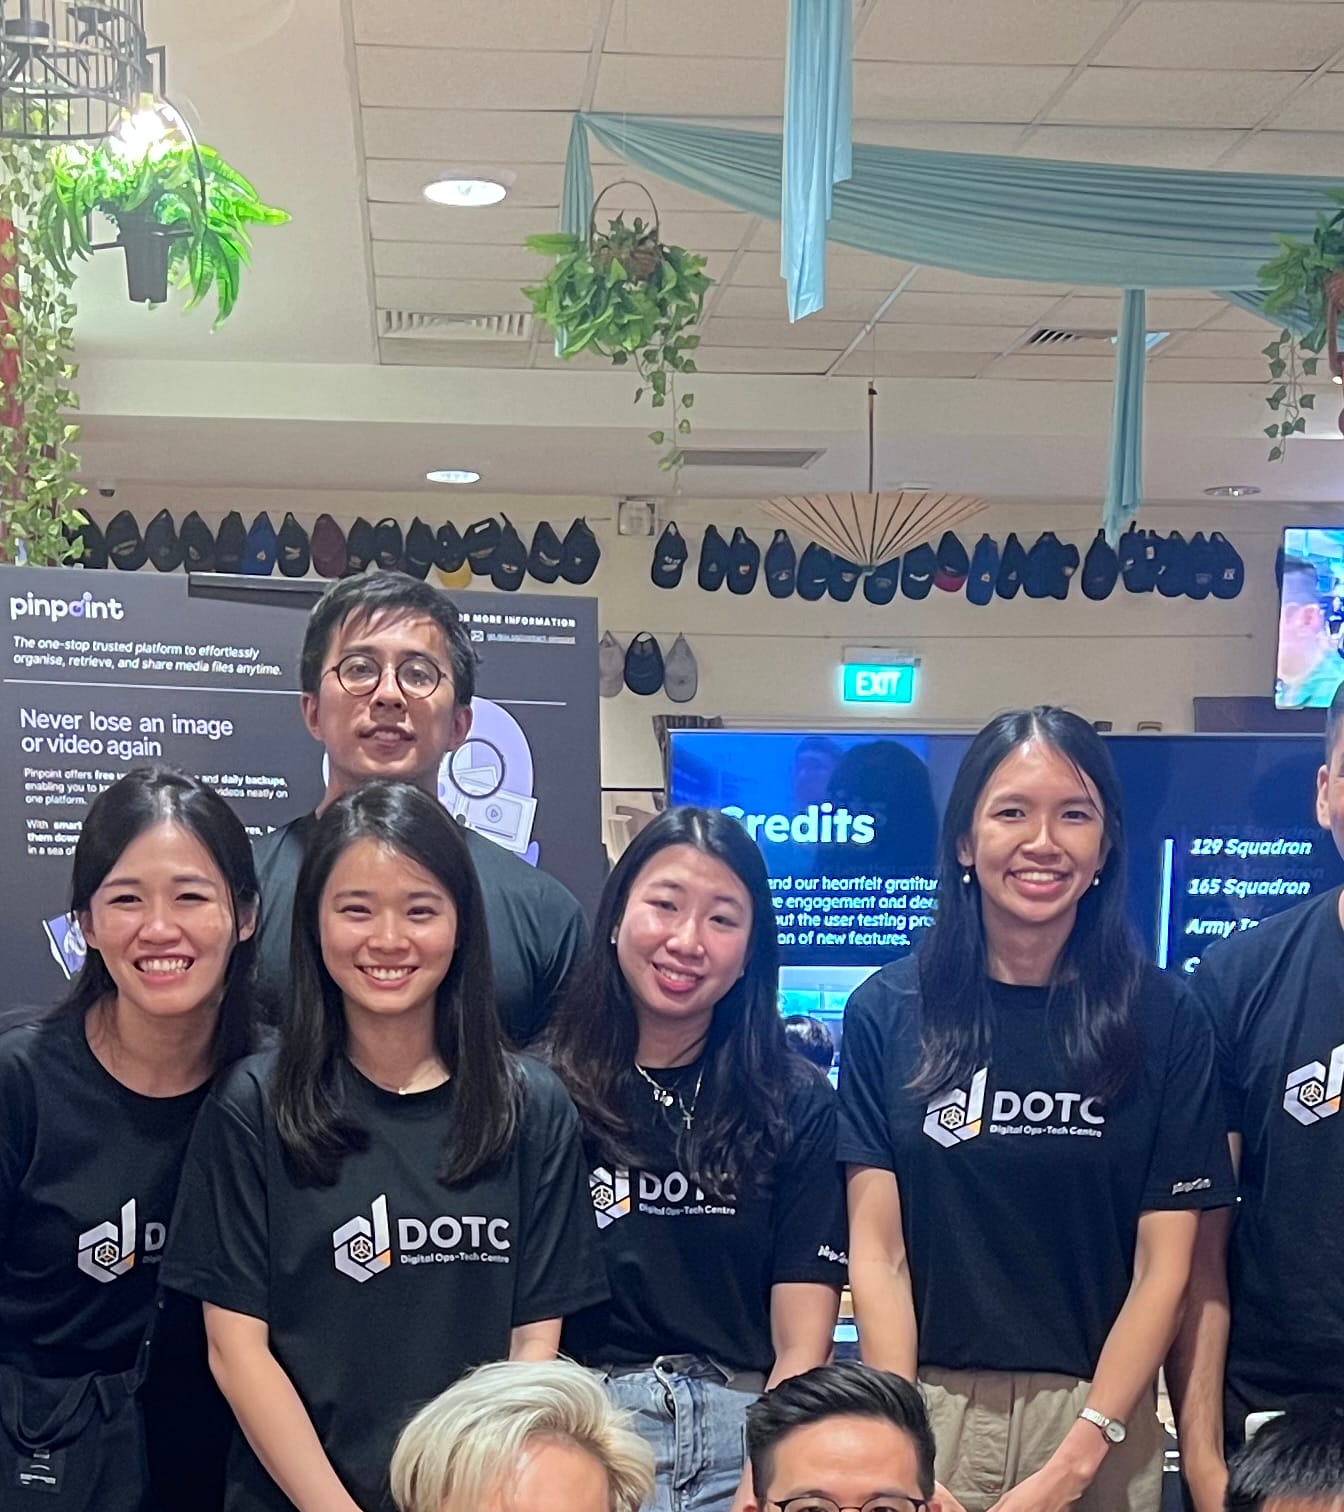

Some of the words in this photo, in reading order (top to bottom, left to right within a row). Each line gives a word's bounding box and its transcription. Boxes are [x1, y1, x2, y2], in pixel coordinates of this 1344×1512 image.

[10, 592, 124, 622] pinpoint
[473, 614, 502, 624] MORE
[505, 615, 576, 628] INFORMATION
[13, 635, 36, 649] The
[38, 639, 90, 653] one-stop
[93, 641, 133, 653] trusted
[135, 642, 182, 657] platform
[185, 644, 197, 655] to
[199, 645, 260, 661] effortlessly
[13, 653, 66, 667] organise,
[68, 655, 115, 669] retrieve,
[117, 657, 140, 669] and
[142, 657, 173, 670] share
[176, 659, 209, 672] media
[212, 660, 234, 673] files
[236, 663, 283, 677] anytime.
[856, 671, 901, 697] EXIT
[20, 708, 84, 730] Never
[90, 710, 132, 732] lose
[139, 716, 165, 733] an
[171, 714, 234, 740] image
[21, 736, 44, 753] or
[46, 733, 104, 755] video
[107, 737, 162, 760] again
[24, 768, 62, 783] Pinpoint
[64, 769, 93, 780] offers
[94, 770, 115, 780] free
[202, 774, 219, 784] and
[221, 775, 244, 787] daily
[25, 781, 65, 794] enabling
[67, 784, 84, 795] you
[87, 783, 98, 793] to
[276, 790, 288, 799] on
[25, 795, 43, 804] one
[45, 794, 88, 806] platform.
[26, 820, 48, 831] With
[53, 821, 82, 832] smart
[27, 833, 53, 843] them
[1190, 838, 1223, 855] 129
[1224, 839, 1313, 859] Squadron
[795, 878, 820, 890] our
[822, 875, 882, 891] heartfelt
[1188, 878, 1221, 895] 165
[1223, 879, 1311, 899] Squadron
[785, 895, 876, 912] engagement
[878, 895, 907, 909] and
[797, 912, 821, 926] the
[824, 915, 855, 927] user
[857, 912, 906, 930] testing
[1185, 918, 1236, 938] Army
[798, 931, 815, 945] of
[816, 933, 847, 945] new
[848, 930, 911, 946] features.
[991, 1090, 1105, 1125] DOTC
[989, 1124, 1023, 1135] Digital
[1024, 1125, 1068, 1136] Ops-Tech
[1070, 1126, 1102, 1138] Centre
[705, 1204, 736, 1215] Centre
[398, 1216, 511, 1250] DOTC
[400, 1253, 434, 1265] Digital
[436, 1252, 479, 1263] Ops-Tech
[481, 1252, 510, 1264] Centre
